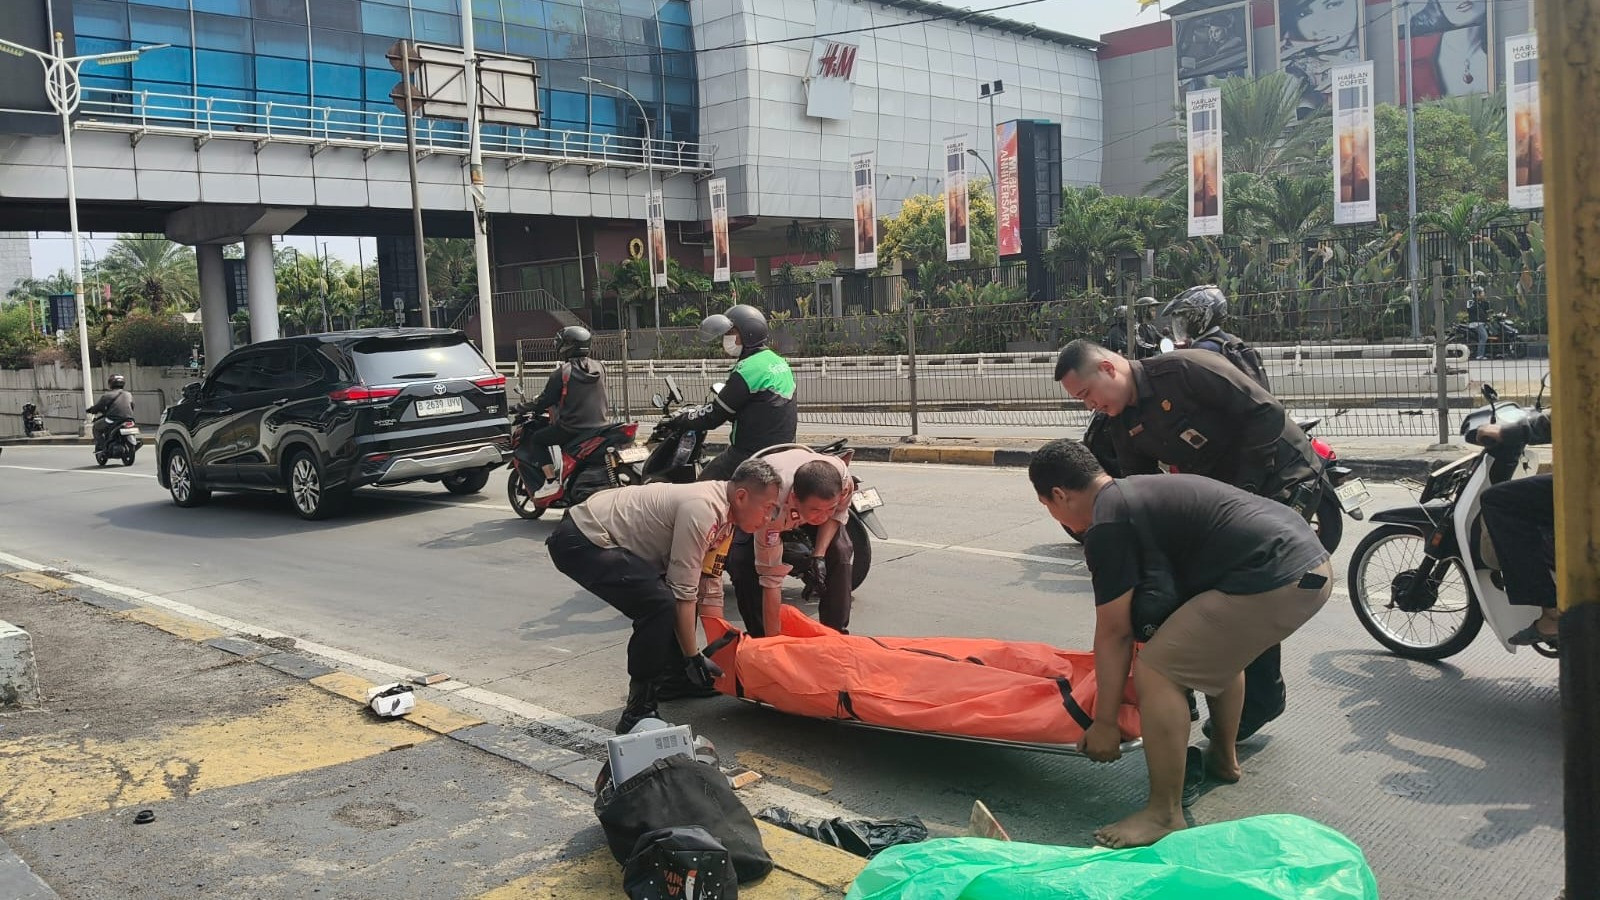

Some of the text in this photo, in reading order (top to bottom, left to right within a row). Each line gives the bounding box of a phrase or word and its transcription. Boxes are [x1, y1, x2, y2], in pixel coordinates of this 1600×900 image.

[1512, 44, 1537, 53] HARL
[1514, 50, 1537, 60] COFF
[817, 43, 857, 80] H&M
[1337, 72, 1368, 80] HARLAN
[1339, 77, 1367, 86] COFFEE
[1191, 96, 1217, 105] HARLAN
[1192, 102, 1215, 110] COFFEE
[1000, 150, 1010, 228] ANNIVERSARY
